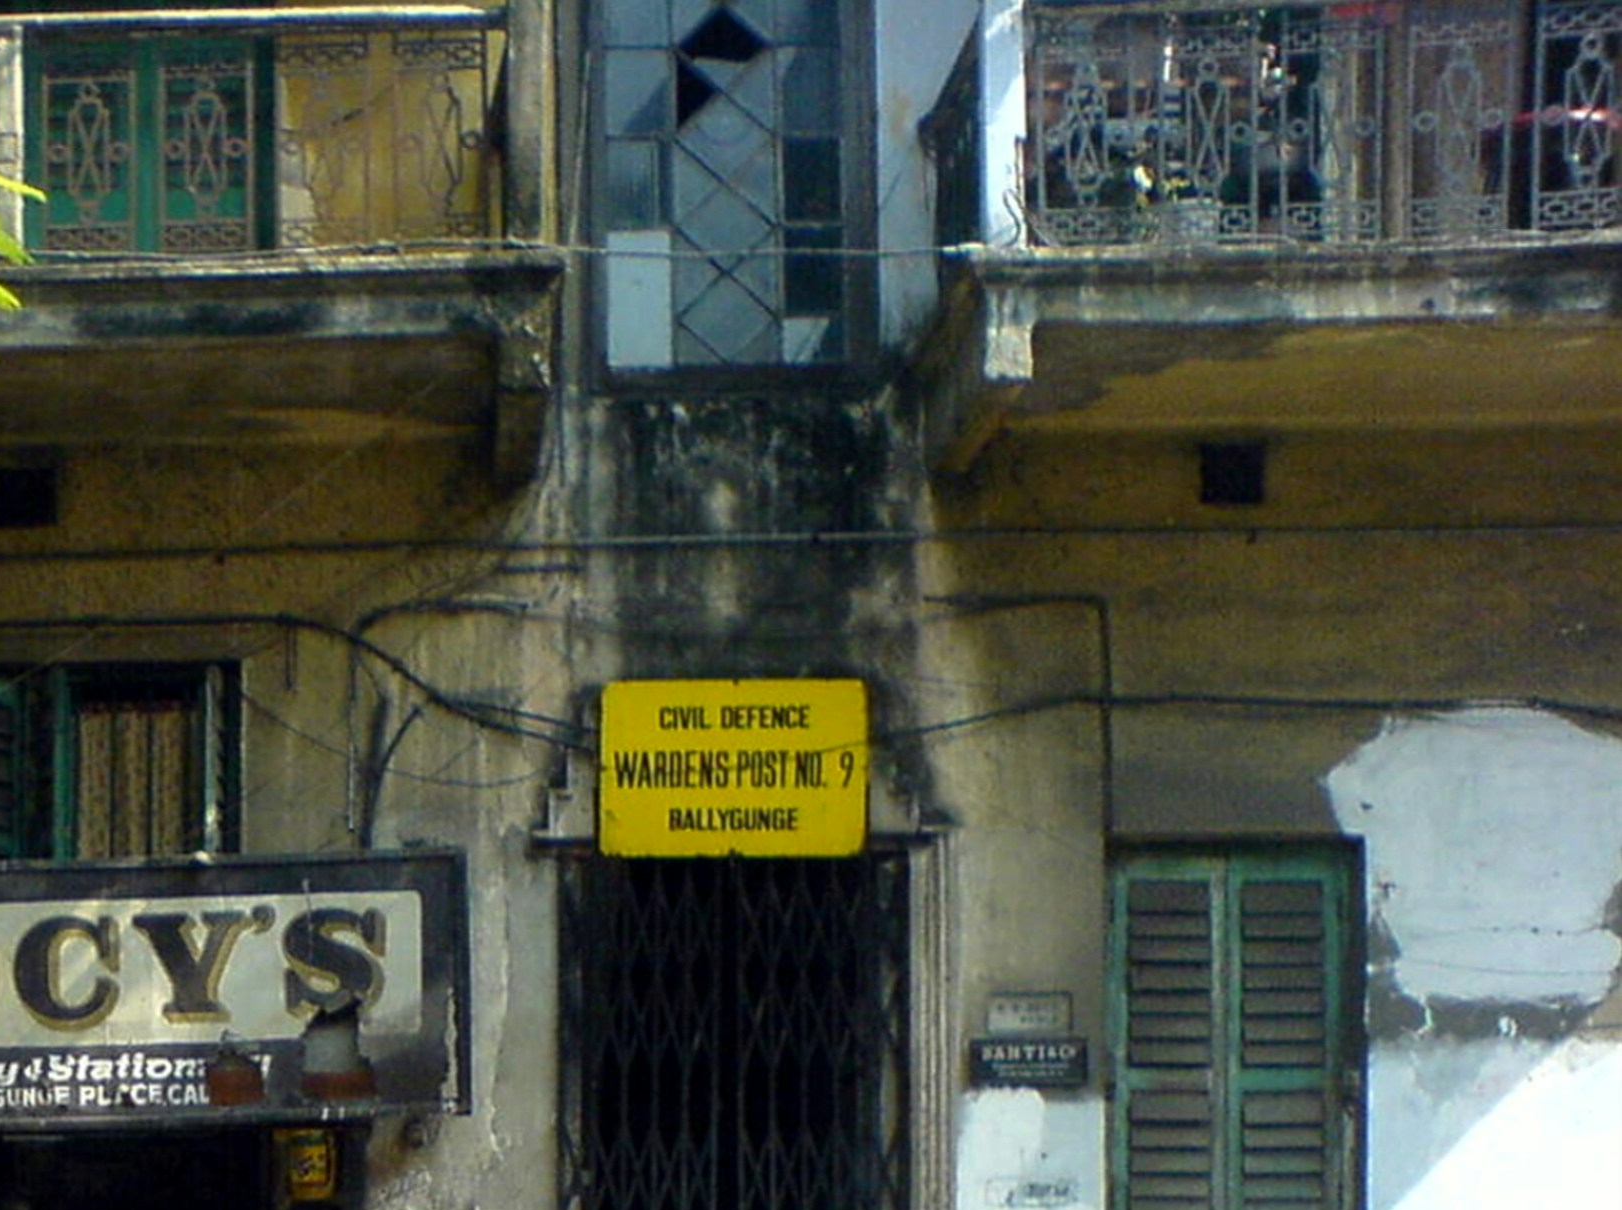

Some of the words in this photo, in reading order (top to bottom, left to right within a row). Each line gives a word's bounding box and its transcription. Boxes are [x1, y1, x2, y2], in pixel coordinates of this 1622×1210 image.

[659, 705, 712, 730] CIVIL
[721, 705, 810, 730] DEFENCE
[614, 750, 729, 789] WARDENS
[736, 750, 789, 788] POST
[840, 750, 854, 788] 9
[668, 808, 799, 831] BALLYGUNGE
